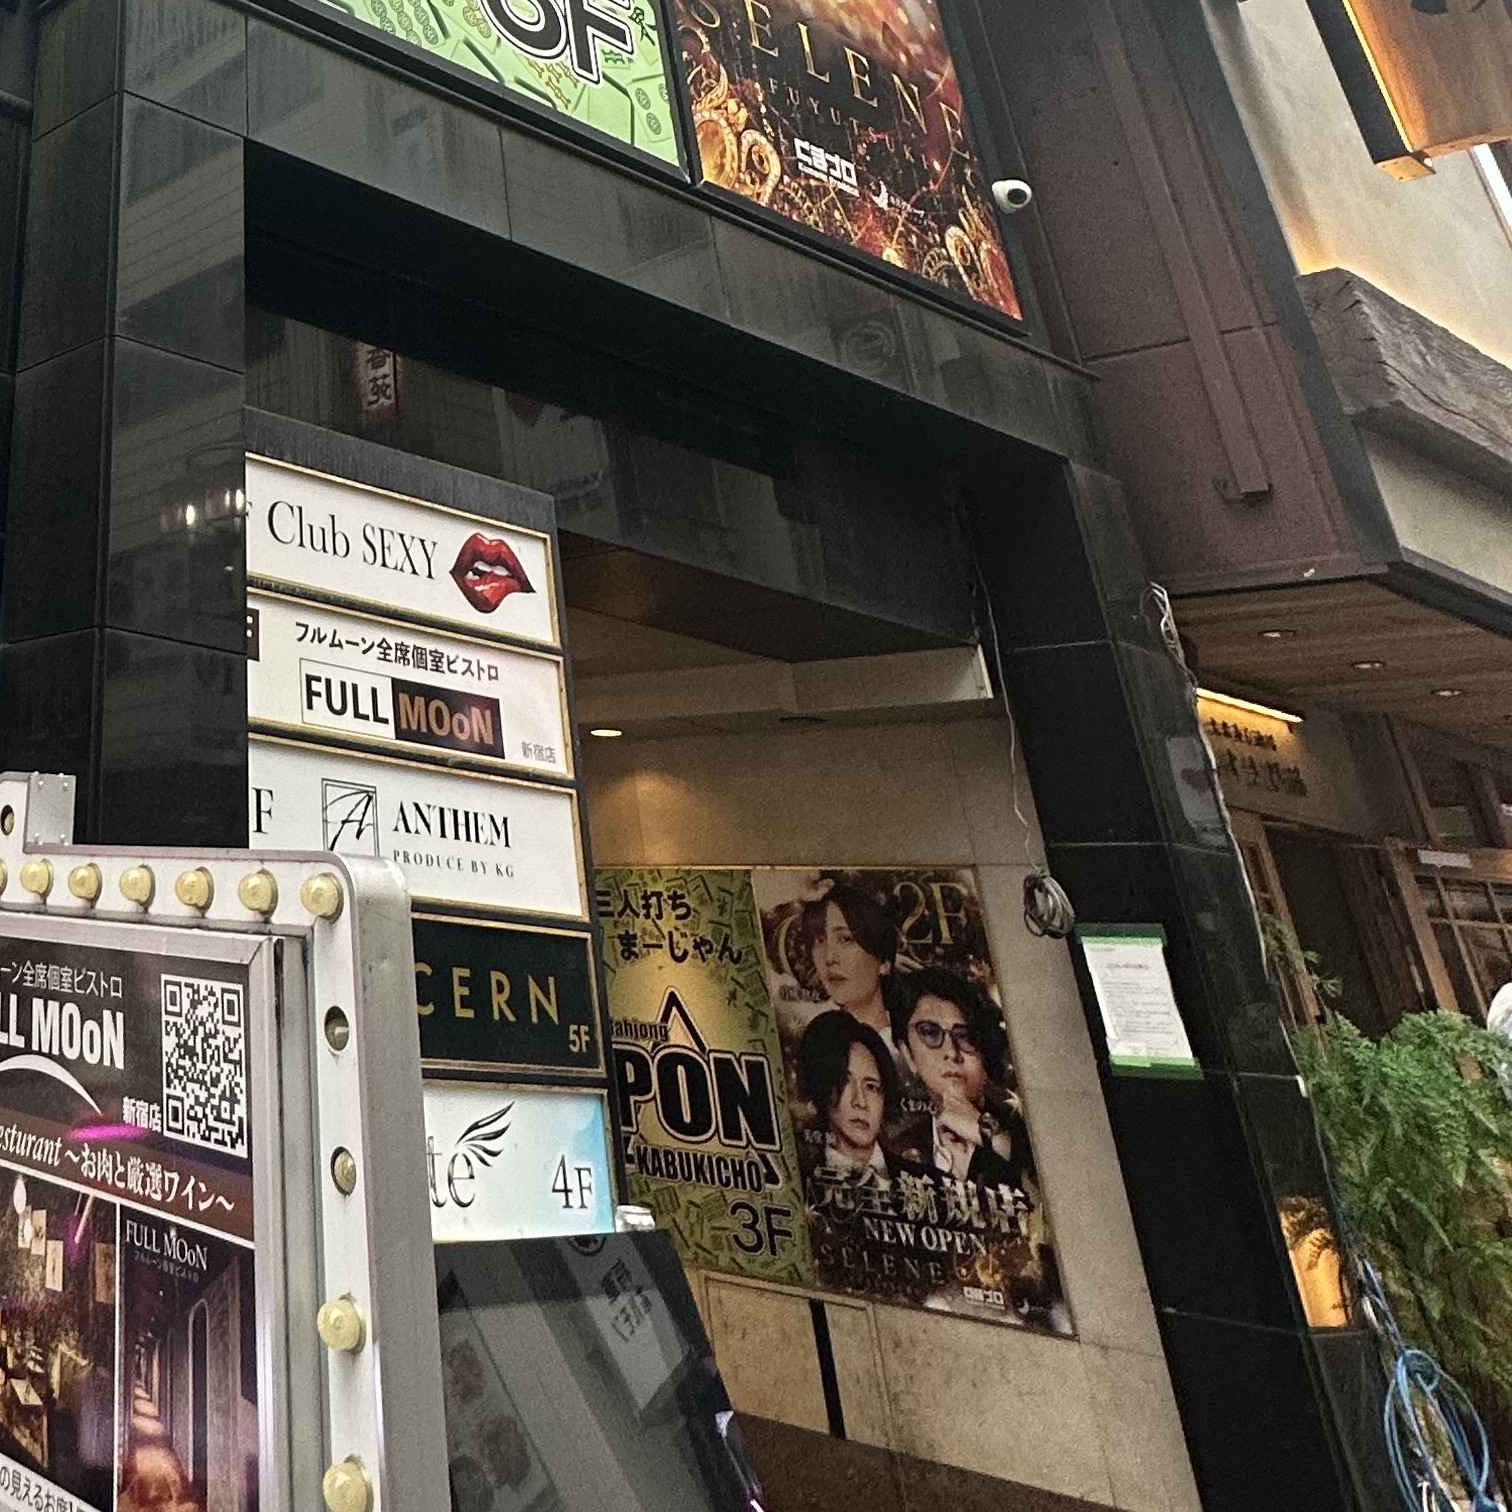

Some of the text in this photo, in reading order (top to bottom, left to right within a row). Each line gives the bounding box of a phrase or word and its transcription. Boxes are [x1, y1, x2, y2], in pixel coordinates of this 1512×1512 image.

[267, 500, 439, 581] Club SEXY
[295, 620, 500, 683] フルムーン全席個室ビストロ
[304, 672, 495, 747] FULL MOoN
[520, 740, 557, 764] 新宿店
[249, 787, 274, 835] F
[392, 800, 512, 848] ANTHEM
[392, 849, 515, 878] PRODUCE BY KG
[595, 888, 692, 921] 三人打ち
[894, 882, 968, 945] 2F
[617, 929, 743, 965] まーじゃん
[31, 997, 126, 1070] MOoN
[414, 966, 591, 1055] CERN 5F
[612, 1020, 669, 1042] ahjong
[121, 1095, 163, 1132] 新宿店
[612, 1042, 782, 1153] PON
[550, 1154, 593, 1210] 4F
[634, 1144, 763, 1193] KABUKICHO
[126, 1219, 160, 1254] FULL
[730, 1200, 793, 1257] 3F
[862, 1216, 988, 1257] NEW OPEN
